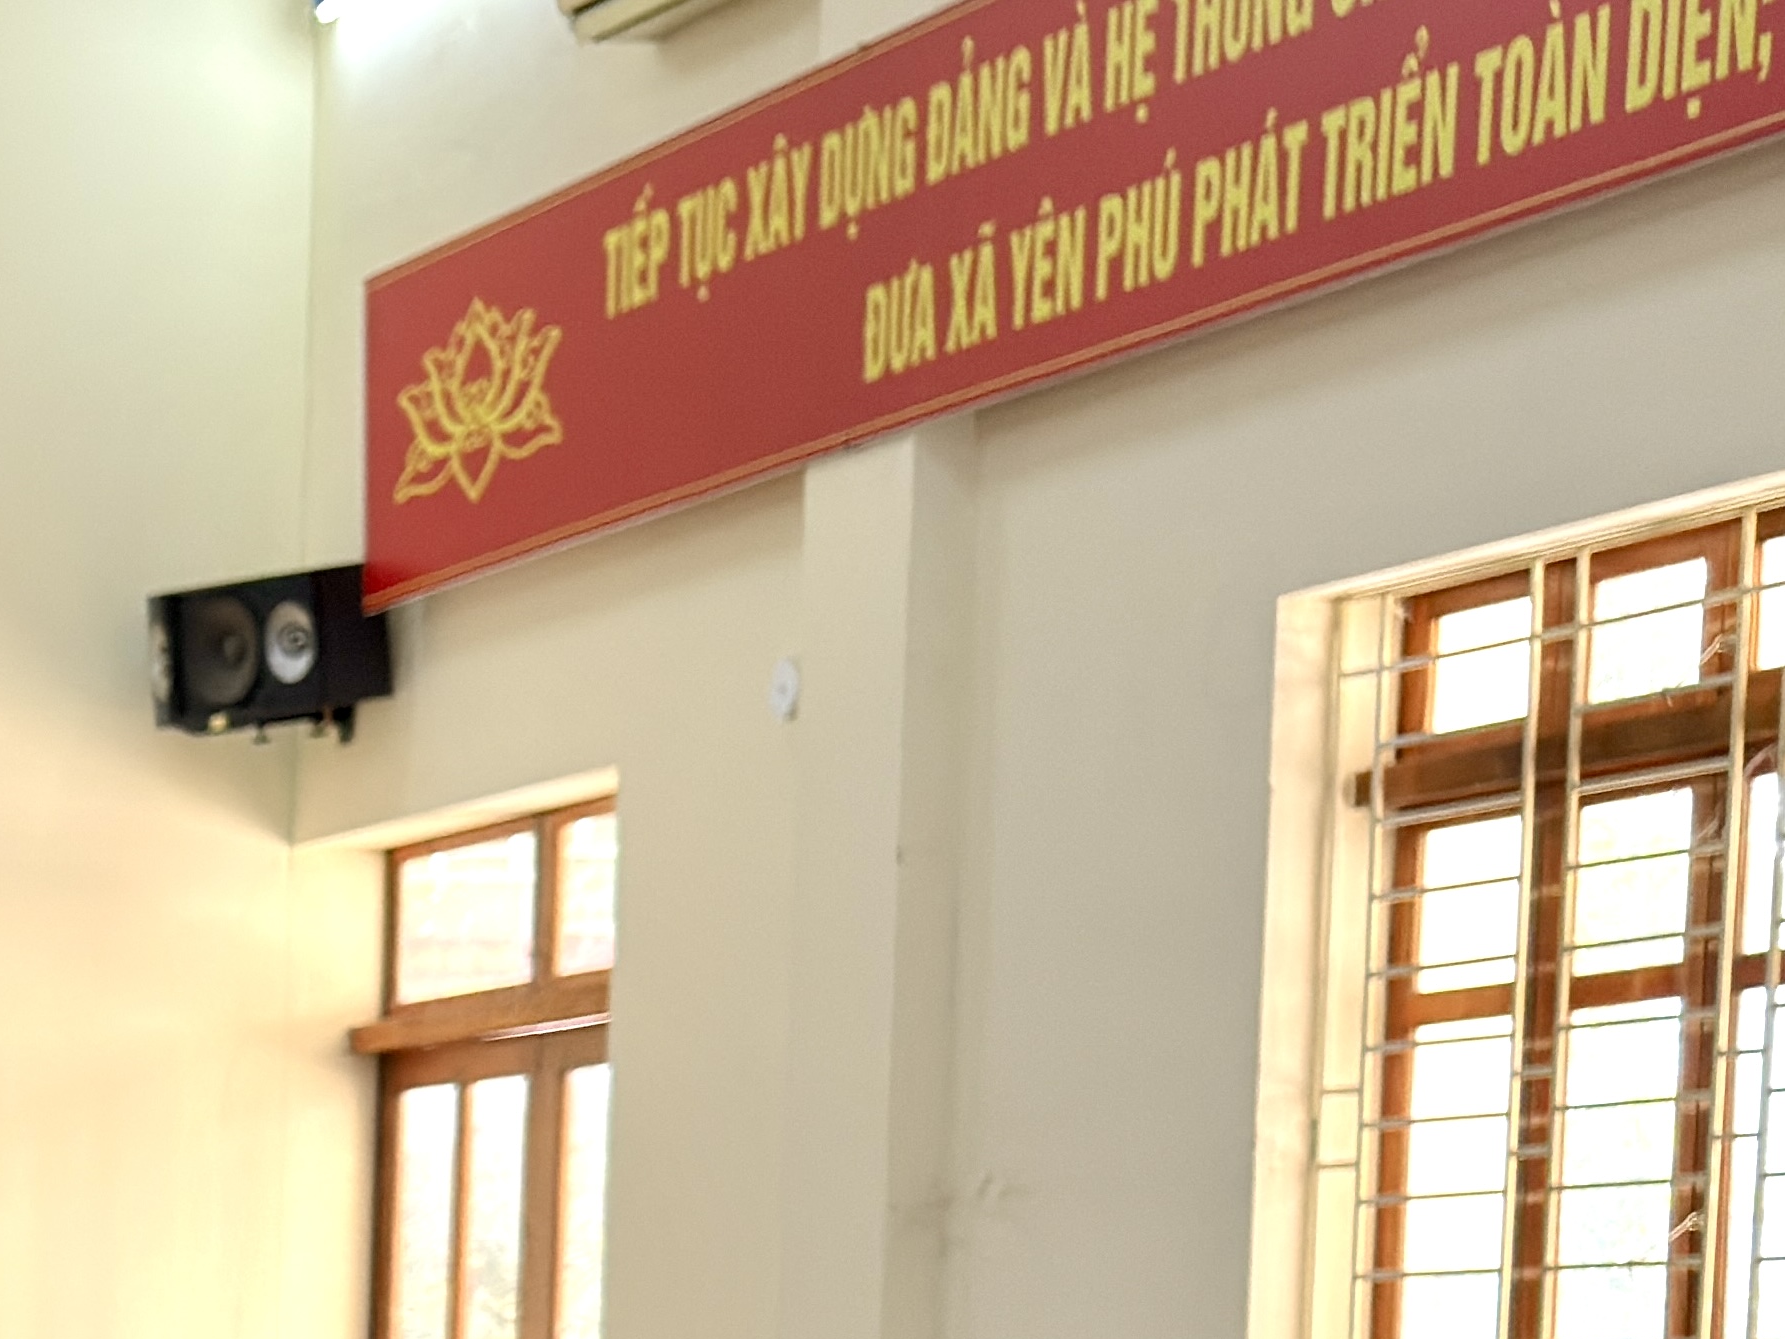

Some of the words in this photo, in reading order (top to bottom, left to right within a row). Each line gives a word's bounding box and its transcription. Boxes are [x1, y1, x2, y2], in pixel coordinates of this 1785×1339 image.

[604, 182, 669, 319] TIẾP
[679, 177, 737, 301] TỤC
[744, 132, 812, 261] XÂY
[819, 96, 917, 240] DỰNG
[926, 35, 1031, 185] ĐẢNG
[1043, 0, 1092, 137] VÀ
[862, 257, 936, 383] ĐƯA
[945, 219, 997, 353] XÃ
[1009, 196, 1087, 331] YÊN
[1096, 148, 1181, 302] PHÚ
[1191, 107, 1308, 268] PHÁT
[1322, 25, 1459, 220] TRIỂN
[1474, 0, 1611, 165] TOÀN
